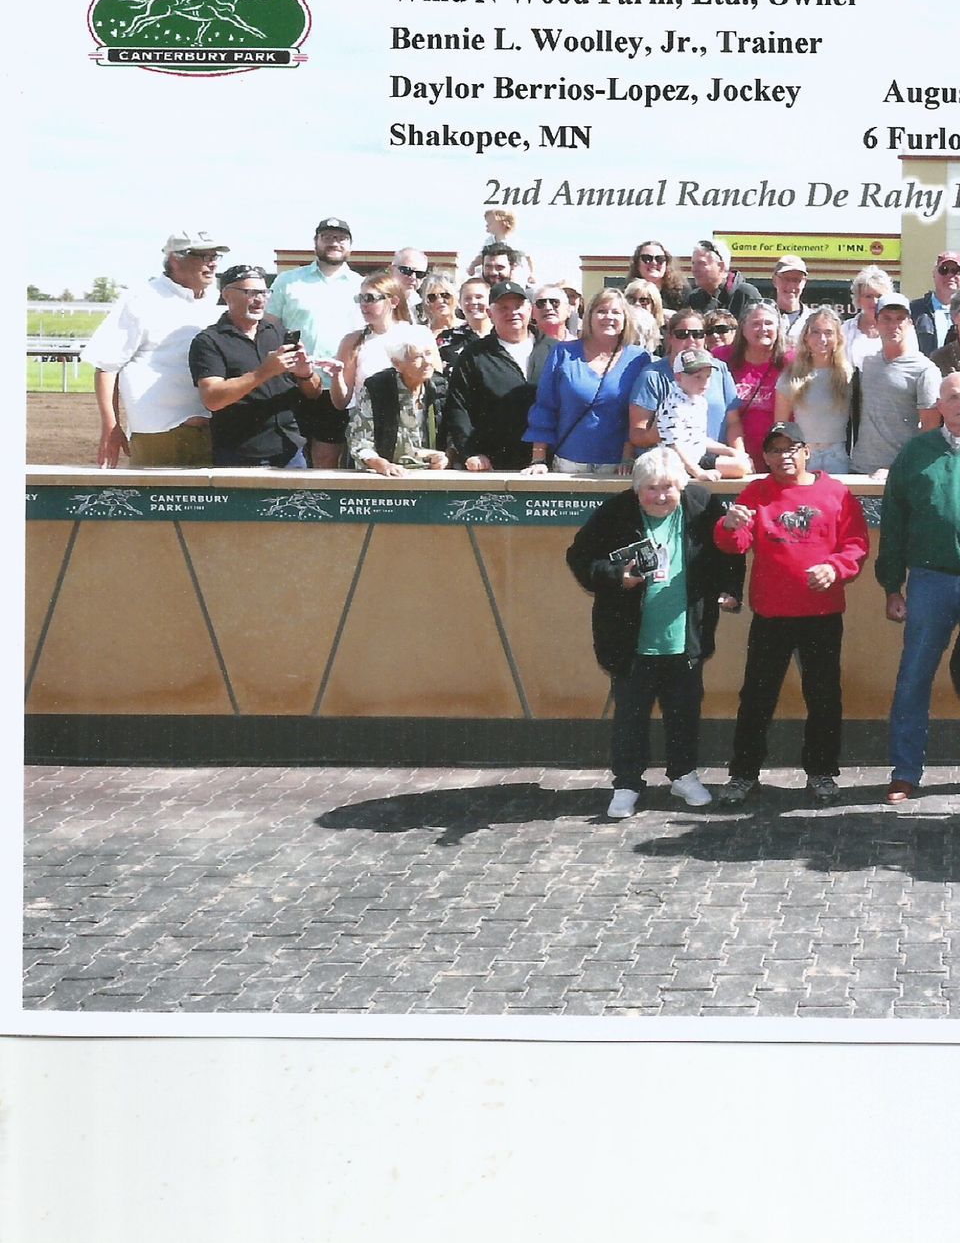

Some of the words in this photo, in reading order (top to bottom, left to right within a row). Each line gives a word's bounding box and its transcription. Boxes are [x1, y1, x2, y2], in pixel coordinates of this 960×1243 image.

[731, 243, 757, 251] Game
[776, 243, 830, 252] Excitement?
[150, 494, 229, 503] CANTERBURY
[339, 498, 417, 507] CANTERBURY
[150, 504, 182, 512] PARK
[525, 500, 604, 508] CANTERBURY
[339, 506, 371, 515] PARK
[525, 509, 558, 517] PARK
